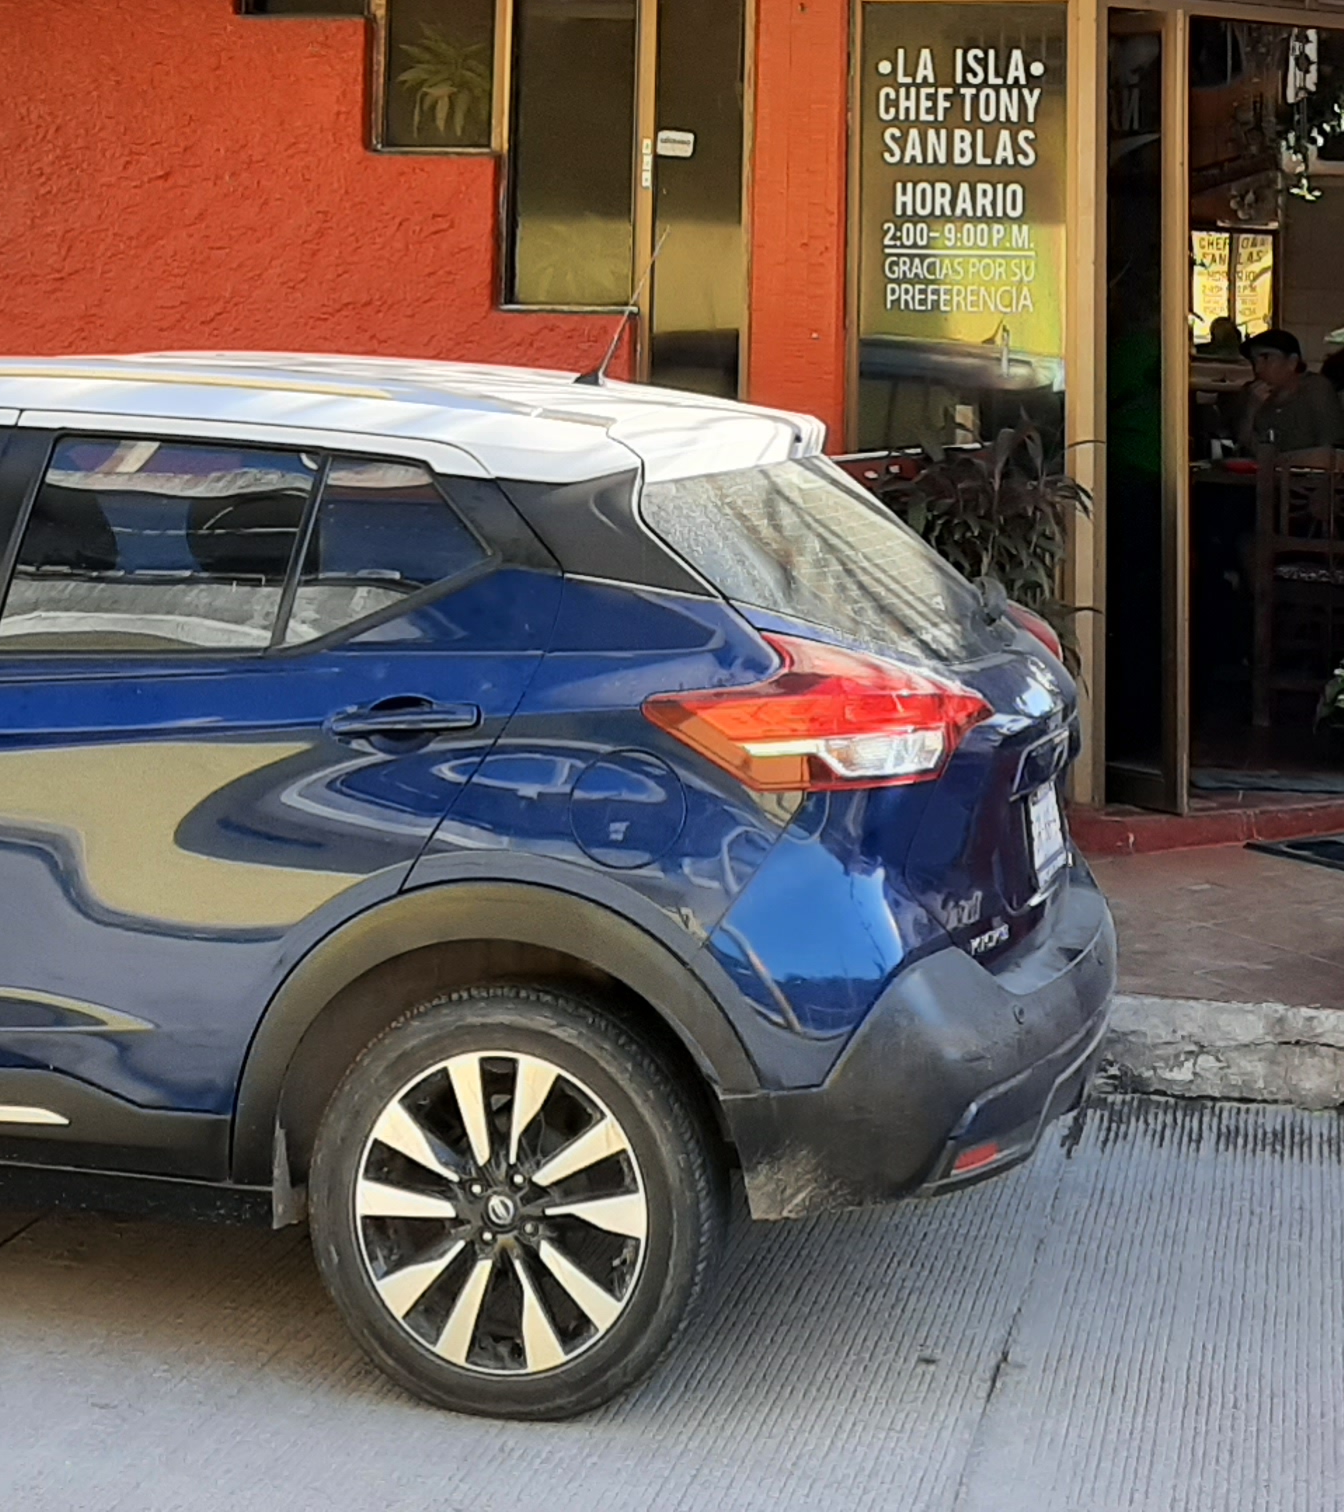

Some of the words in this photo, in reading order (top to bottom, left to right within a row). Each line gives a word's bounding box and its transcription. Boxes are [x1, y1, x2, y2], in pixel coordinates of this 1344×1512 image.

[896, 48, 935, 84] LA
[954, 48, 1028, 85] ISLA
[878, 86, 954, 123] CHEF
[959, 87, 1042, 124] TONY
[882, 127, 948, 165] SAN
[953, 128, 1037, 167] BLAS
[894, 181, 1025, 218] HORARIO
[884, 256, 965, 281] GRACIAS
[968, 258, 1006, 282] POR
[1012, 259, 1036, 282] SU
[885, 283, 1034, 313] PREFERENCIA
